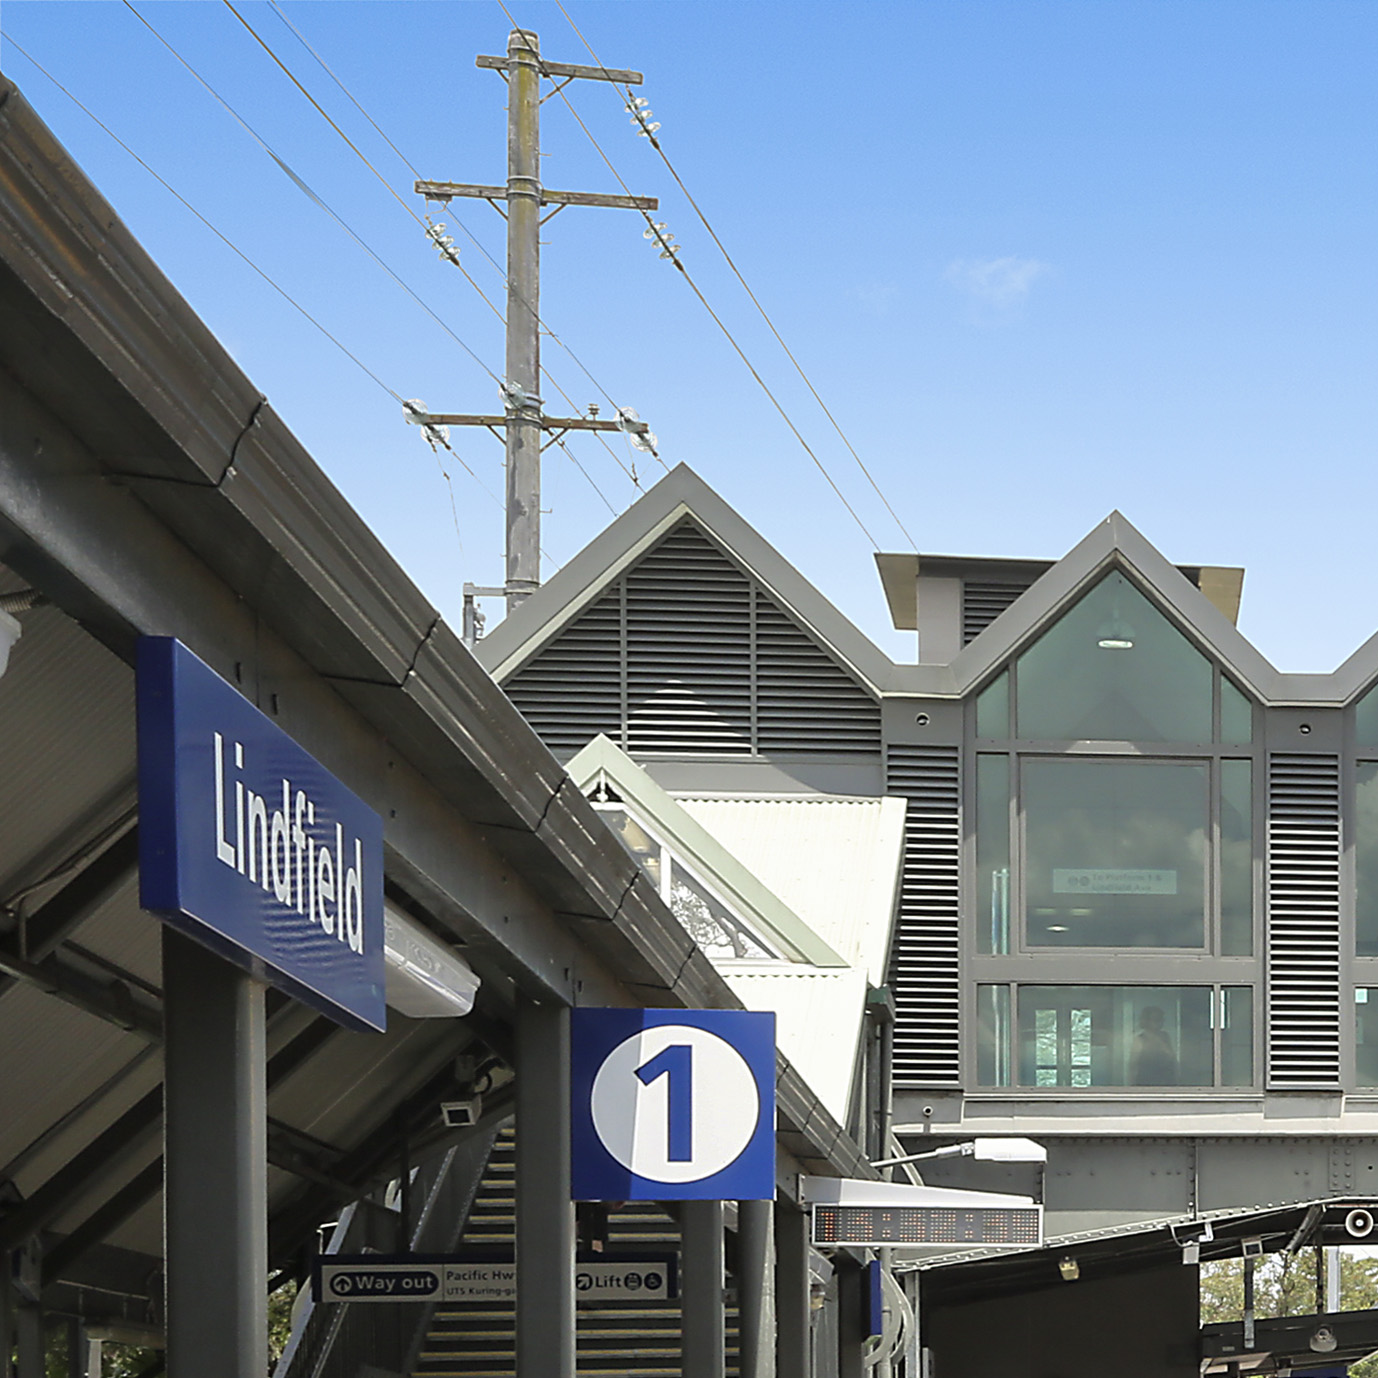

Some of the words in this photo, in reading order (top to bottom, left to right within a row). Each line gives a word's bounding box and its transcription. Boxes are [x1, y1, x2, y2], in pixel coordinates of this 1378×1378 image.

[213, 731, 364, 956] Lindfield
[633, 1044, 693, 1164] 1
[446, 1269, 488, 1281] Pacific
[492, 1269, 516, 1281] Hw
[595, 1275, 622, 1288] Lift
[355, 1276, 395, 1292] Way
[402, 1275, 435, 1290] out
[446, 1287, 466, 1296] UTS
[468, 1286, 517, 1297] Kuring-ga
